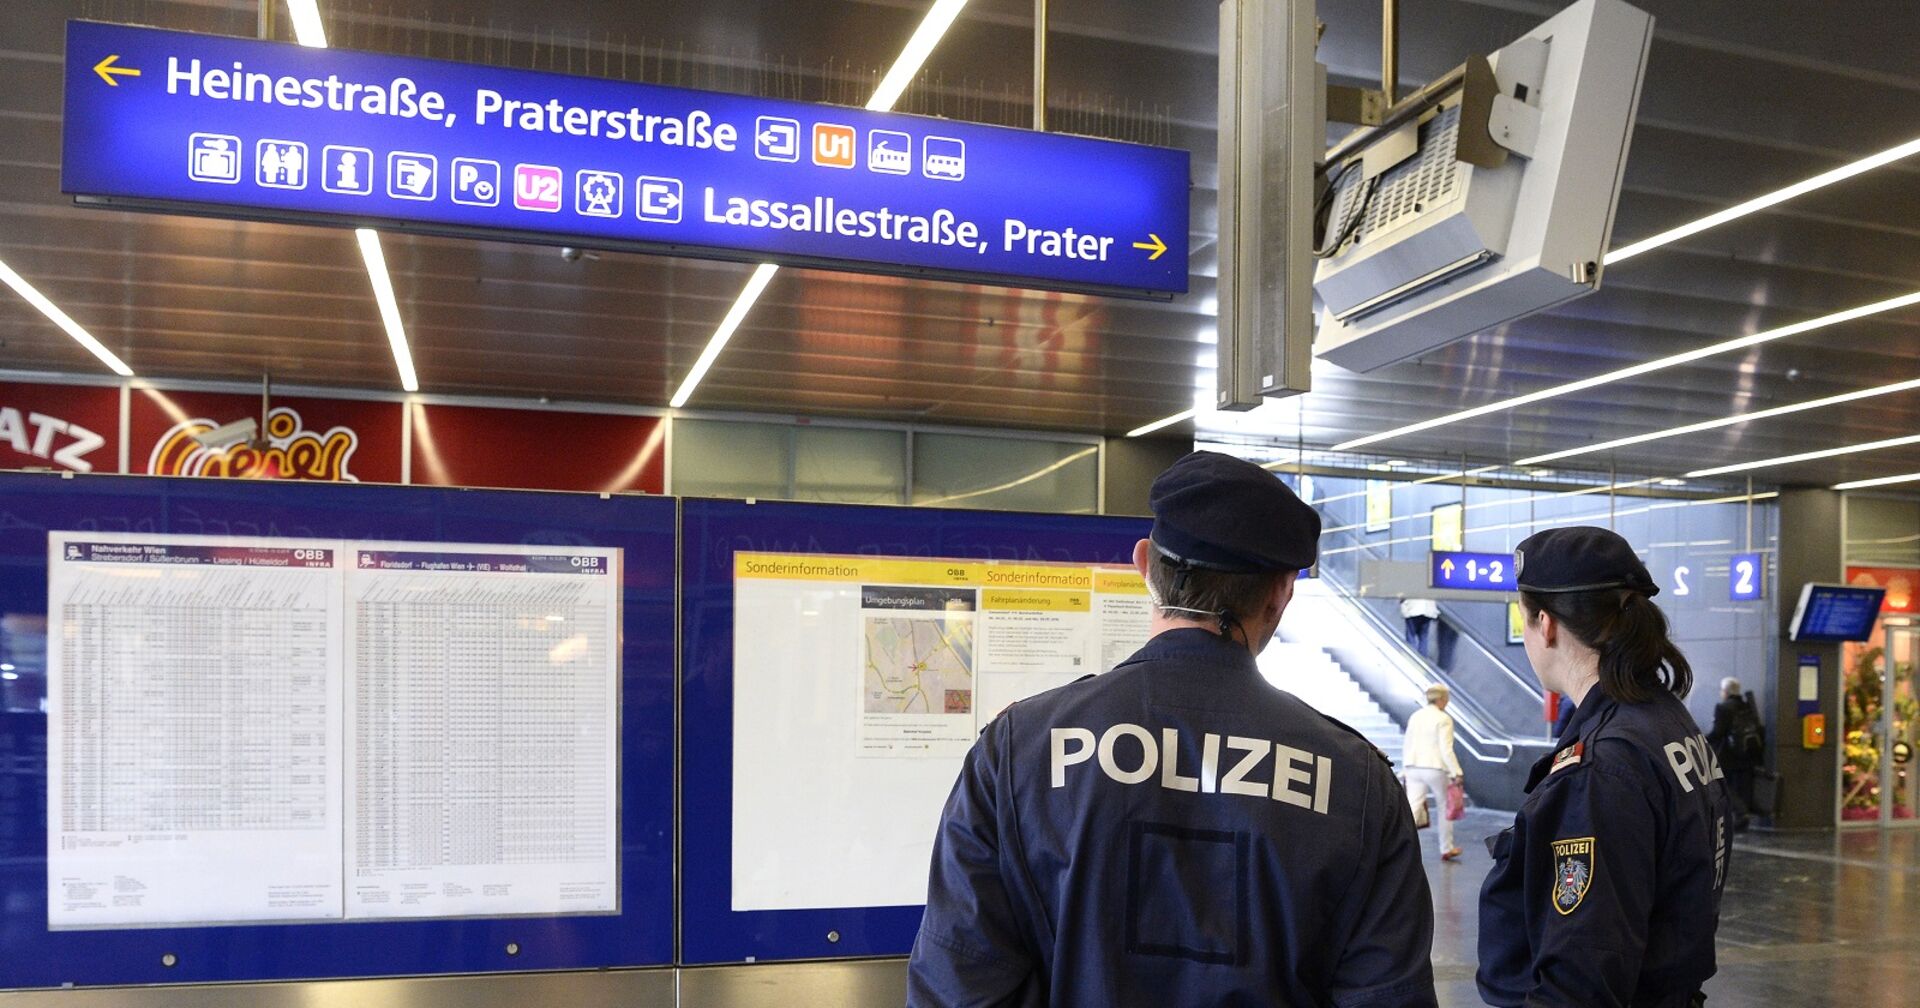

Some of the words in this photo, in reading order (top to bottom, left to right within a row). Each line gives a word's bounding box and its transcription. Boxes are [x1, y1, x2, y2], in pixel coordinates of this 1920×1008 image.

[166, 56, 457, 128] Heinestraße,
[476, 89, 737, 152] Praterstraße
[819, 131, 850, 159] U1
[517, 173, 559, 203] U2
[704, 186, 988, 255] Lassallestraße,
[1003, 218, 1114, 262] Prater
[91, 544, 142, 555] Nahverkehr
[143, 546, 167, 555] Wien
[293, 548, 325, 561] ÖBB
[571, 556, 599, 568] ÖBB
[746, 560, 858, 577] Sonderinformation
[1465, 558, 1504, 583] 1-2
[987, 569, 1090, 586] Sonderinformation
[1735, 560, 1754, 594] 2
[865, 595, 926, 608] Umgebungsplan
[1050, 723, 1332, 815] POLIZEI
[1555, 841, 1590, 858] POLIZEI
